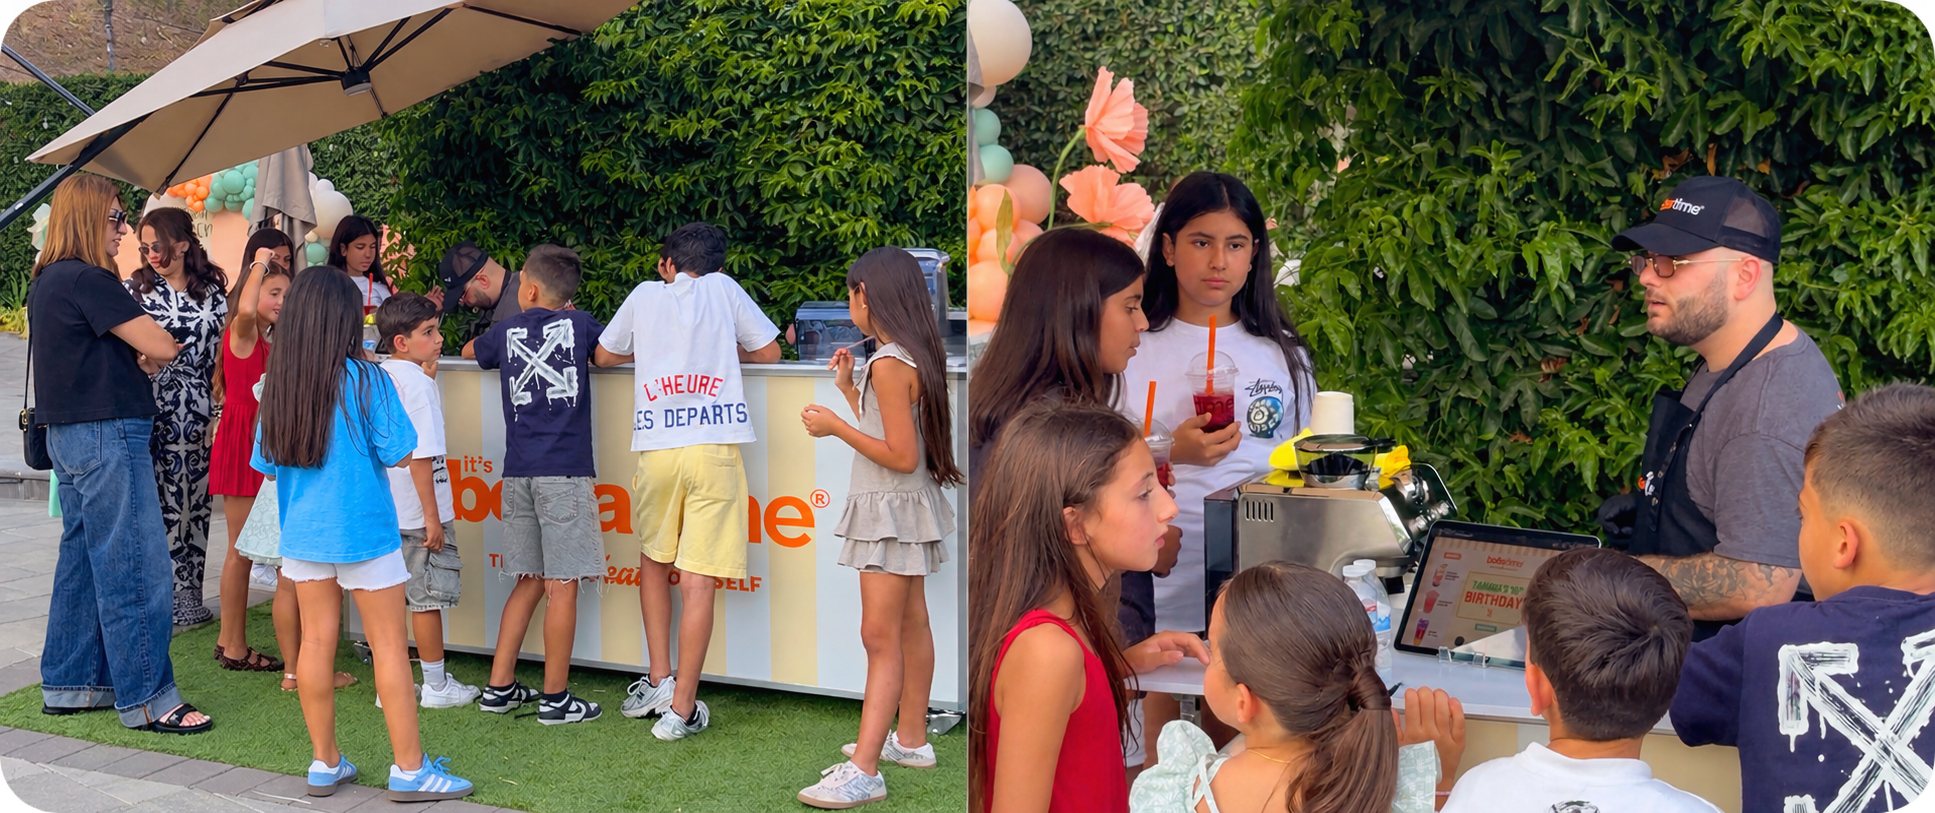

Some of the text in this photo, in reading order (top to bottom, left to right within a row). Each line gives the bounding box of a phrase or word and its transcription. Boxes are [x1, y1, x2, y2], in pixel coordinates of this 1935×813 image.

[644, 374, 724, 402] L'HEURE
[634, 402, 748, 431] ES DEPARTS
[463, 455, 493, 474] it's
[1464, 591, 1523, 610] BIRTHDAY
